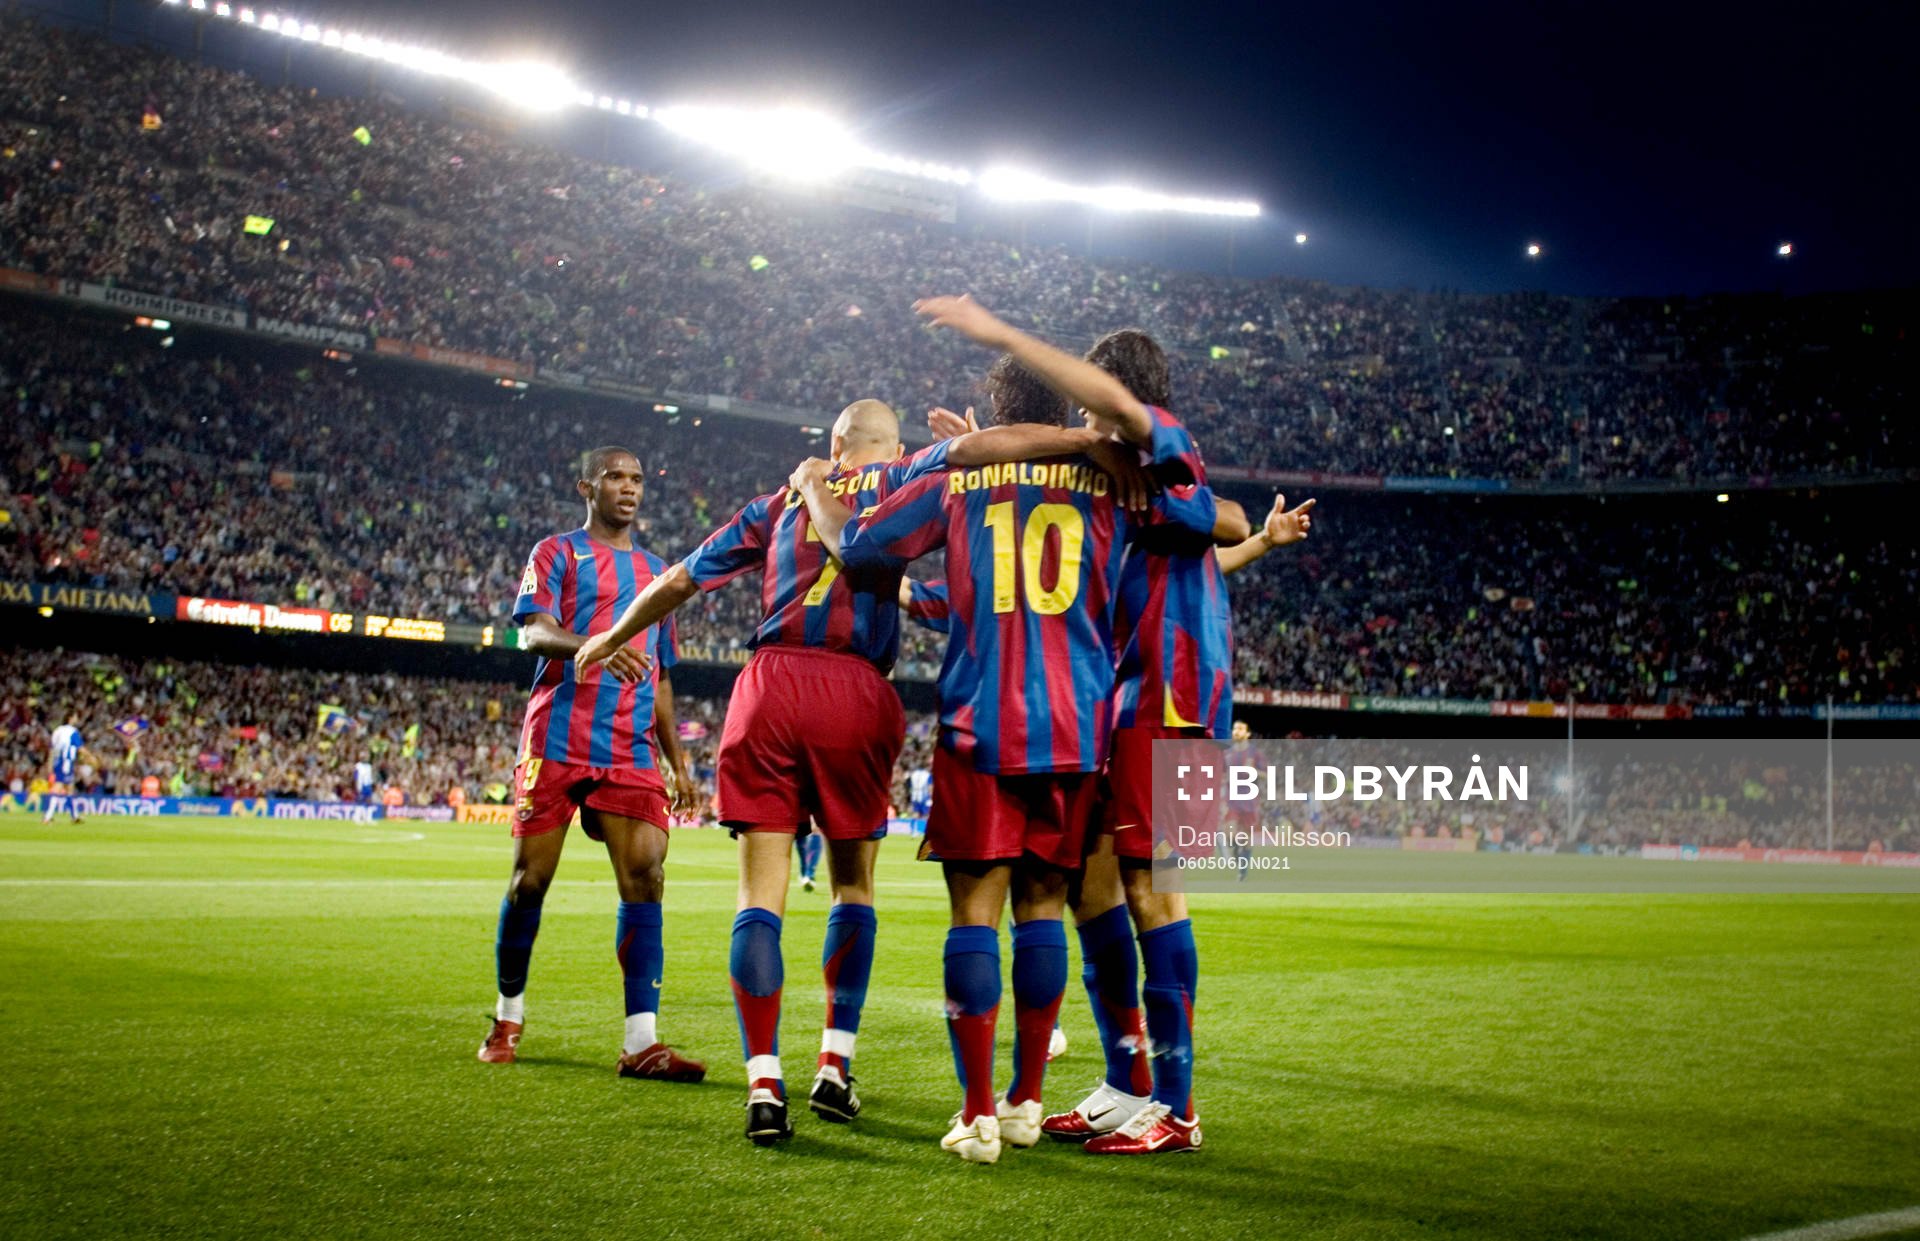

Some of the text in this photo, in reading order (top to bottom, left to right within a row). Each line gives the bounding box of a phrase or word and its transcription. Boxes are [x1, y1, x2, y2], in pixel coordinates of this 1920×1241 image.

[105, 288, 237, 324] HORMIPRESA
[784, 470, 881, 510] LSON
[950, 462, 1108, 497] RONALDINHO
[984, 500, 1085, 615] 10
[42, 585, 152, 613] LAIETANA
[187, 597, 261, 627] Estrella
[1232, 689, 1341, 708] aixa Sabadell
[1371, 698, 1437, 714] Groupama
[1439, 698, 1490, 716] Seguros
[522, 758, 543, 790] 9
